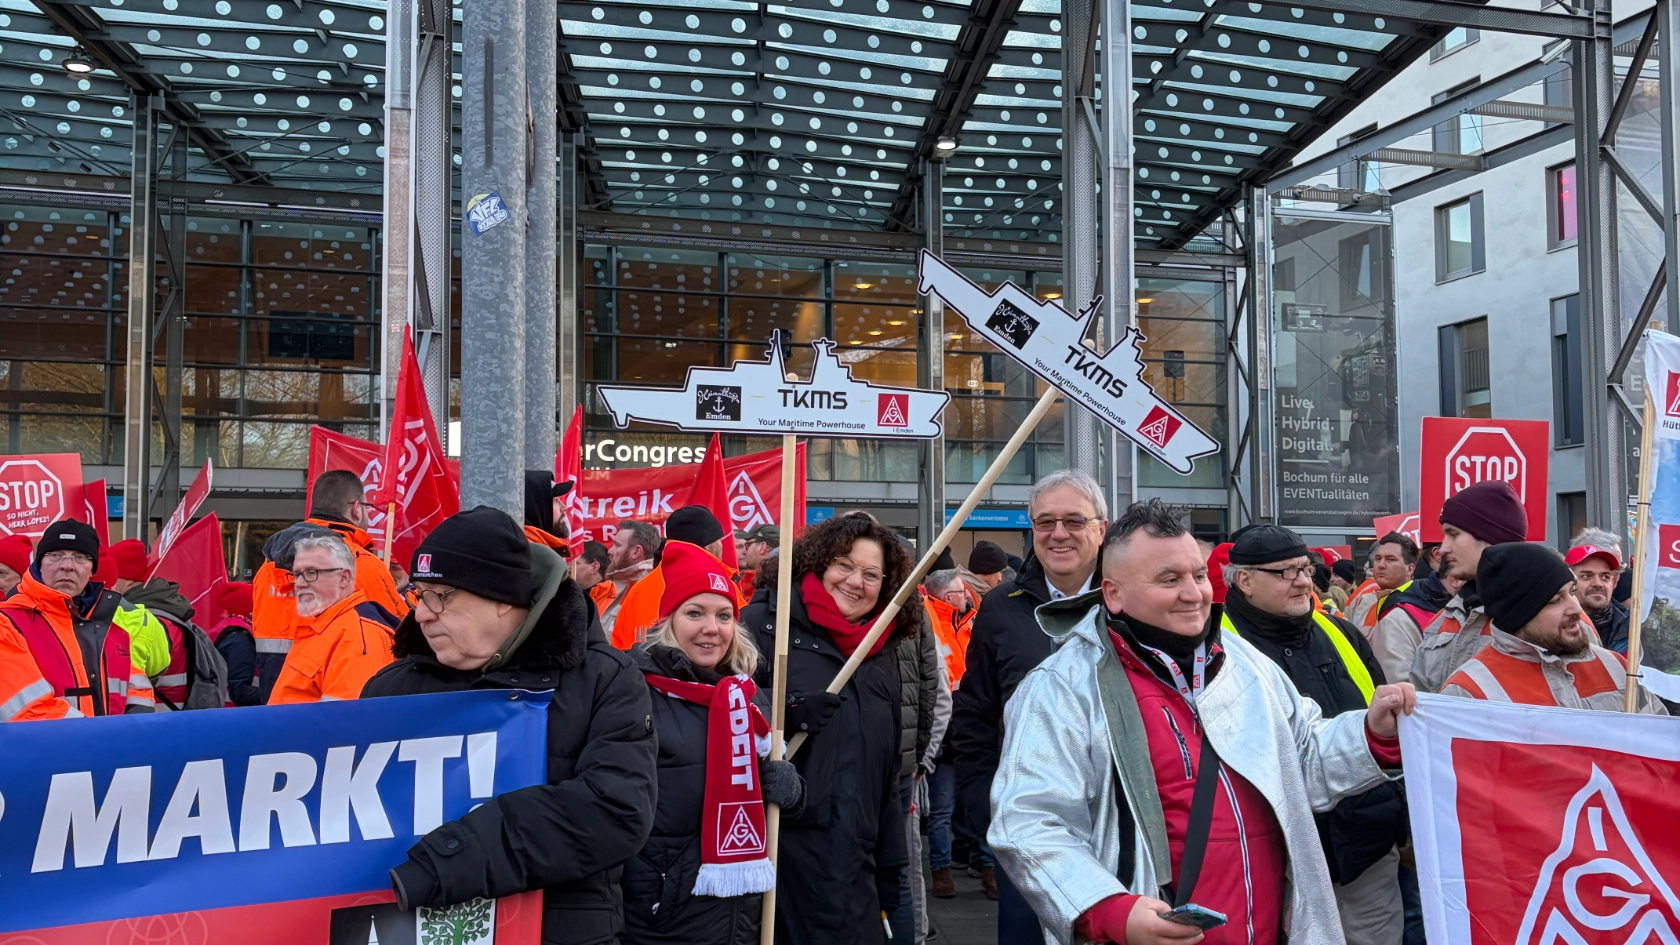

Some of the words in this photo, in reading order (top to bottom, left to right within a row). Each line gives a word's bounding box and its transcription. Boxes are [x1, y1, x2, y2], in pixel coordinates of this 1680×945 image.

[993, 324, 1016, 344] Emden
[1064, 345, 1128, 399] TKMS
[778, 388, 848, 410] TKMS
[1034, 357, 1052, 373] Your
[1050, 369, 1082, 396] Maritime
[1082, 391, 1126, 426] Powerhouse
[1281, 395, 1315, 409] Live.
[705, 411, 732, 420] Emden
[758, 417, 776, 427] Your
[778, 418, 814, 428] Maritime
[816, 420, 866, 430] Powerhouse
[1282, 416, 1335, 432] Hybrid.
[580, 440, 707, 468] rCongres
[1282, 437, 1334, 453] Digital.
[1283, 471, 1328, 483] Bochum
[1331, 472, 1346, 483] für
[1348, 474, 1370, 484] alle
[1455, 455, 1519, 493] STOP
[0, 480, 54, 511] STOP
[583, 488, 674, 519] treik
[1284, 488, 1370, 500] EVENTualitäten
[7, 512, 17, 520] SO
[31, 731, 498, 874] MARKT!
